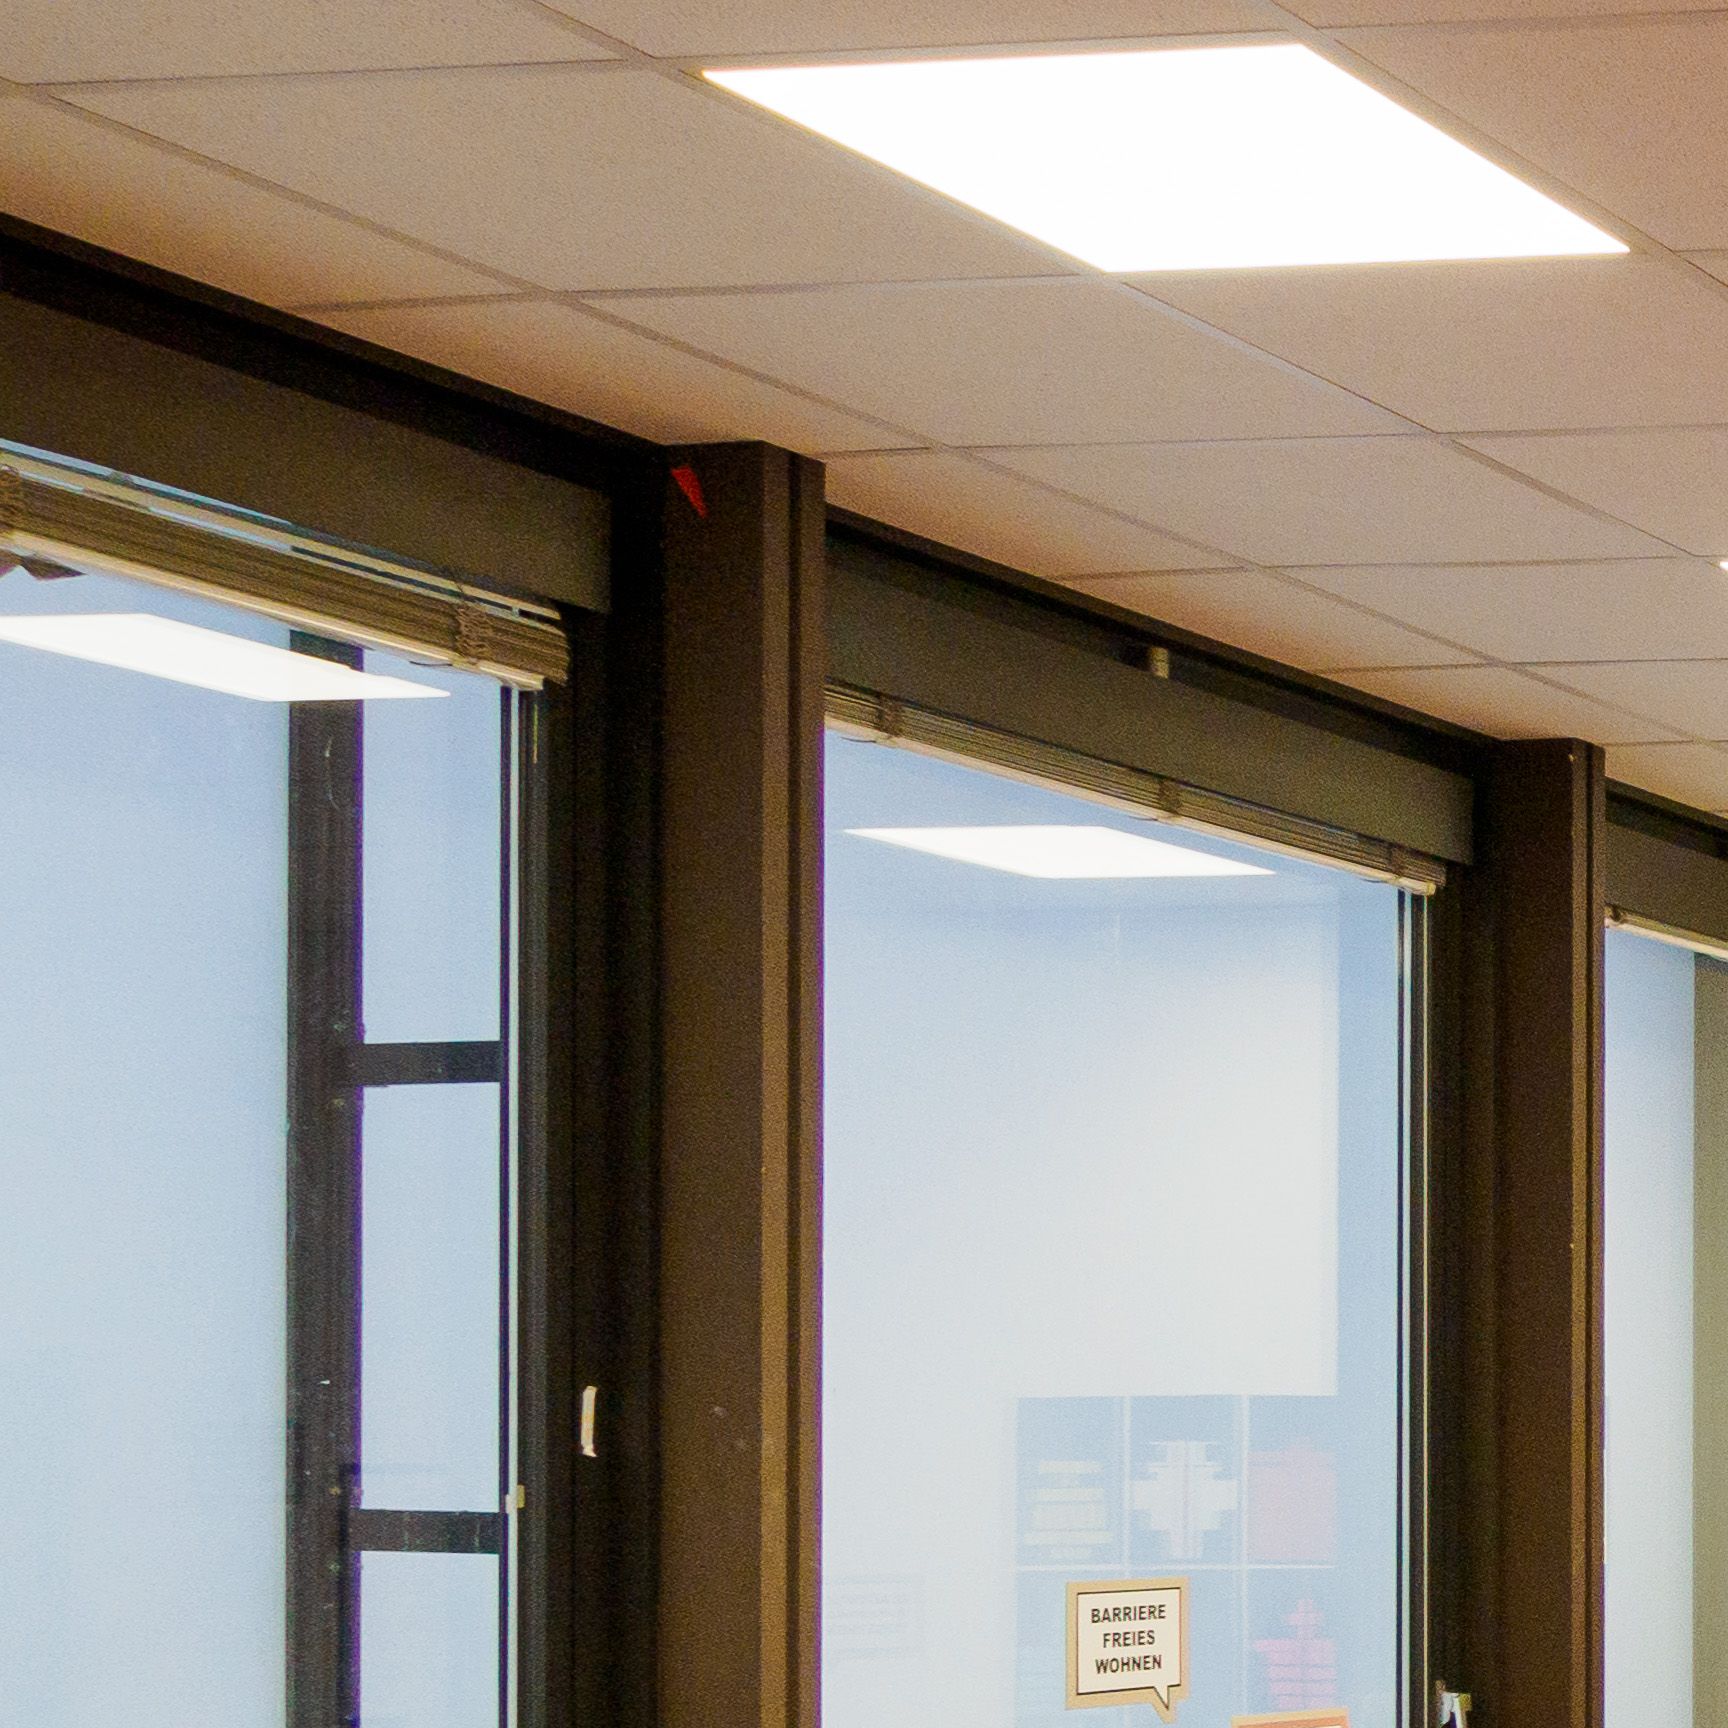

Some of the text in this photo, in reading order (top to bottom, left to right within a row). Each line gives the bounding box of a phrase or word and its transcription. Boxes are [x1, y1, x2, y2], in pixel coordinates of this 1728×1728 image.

[1091, 1604, 1167, 1624] BARRIERE
[1102, 1630, 1156, 1649] FREIES
[1095, 1655, 1163, 1675] WOHNEN
